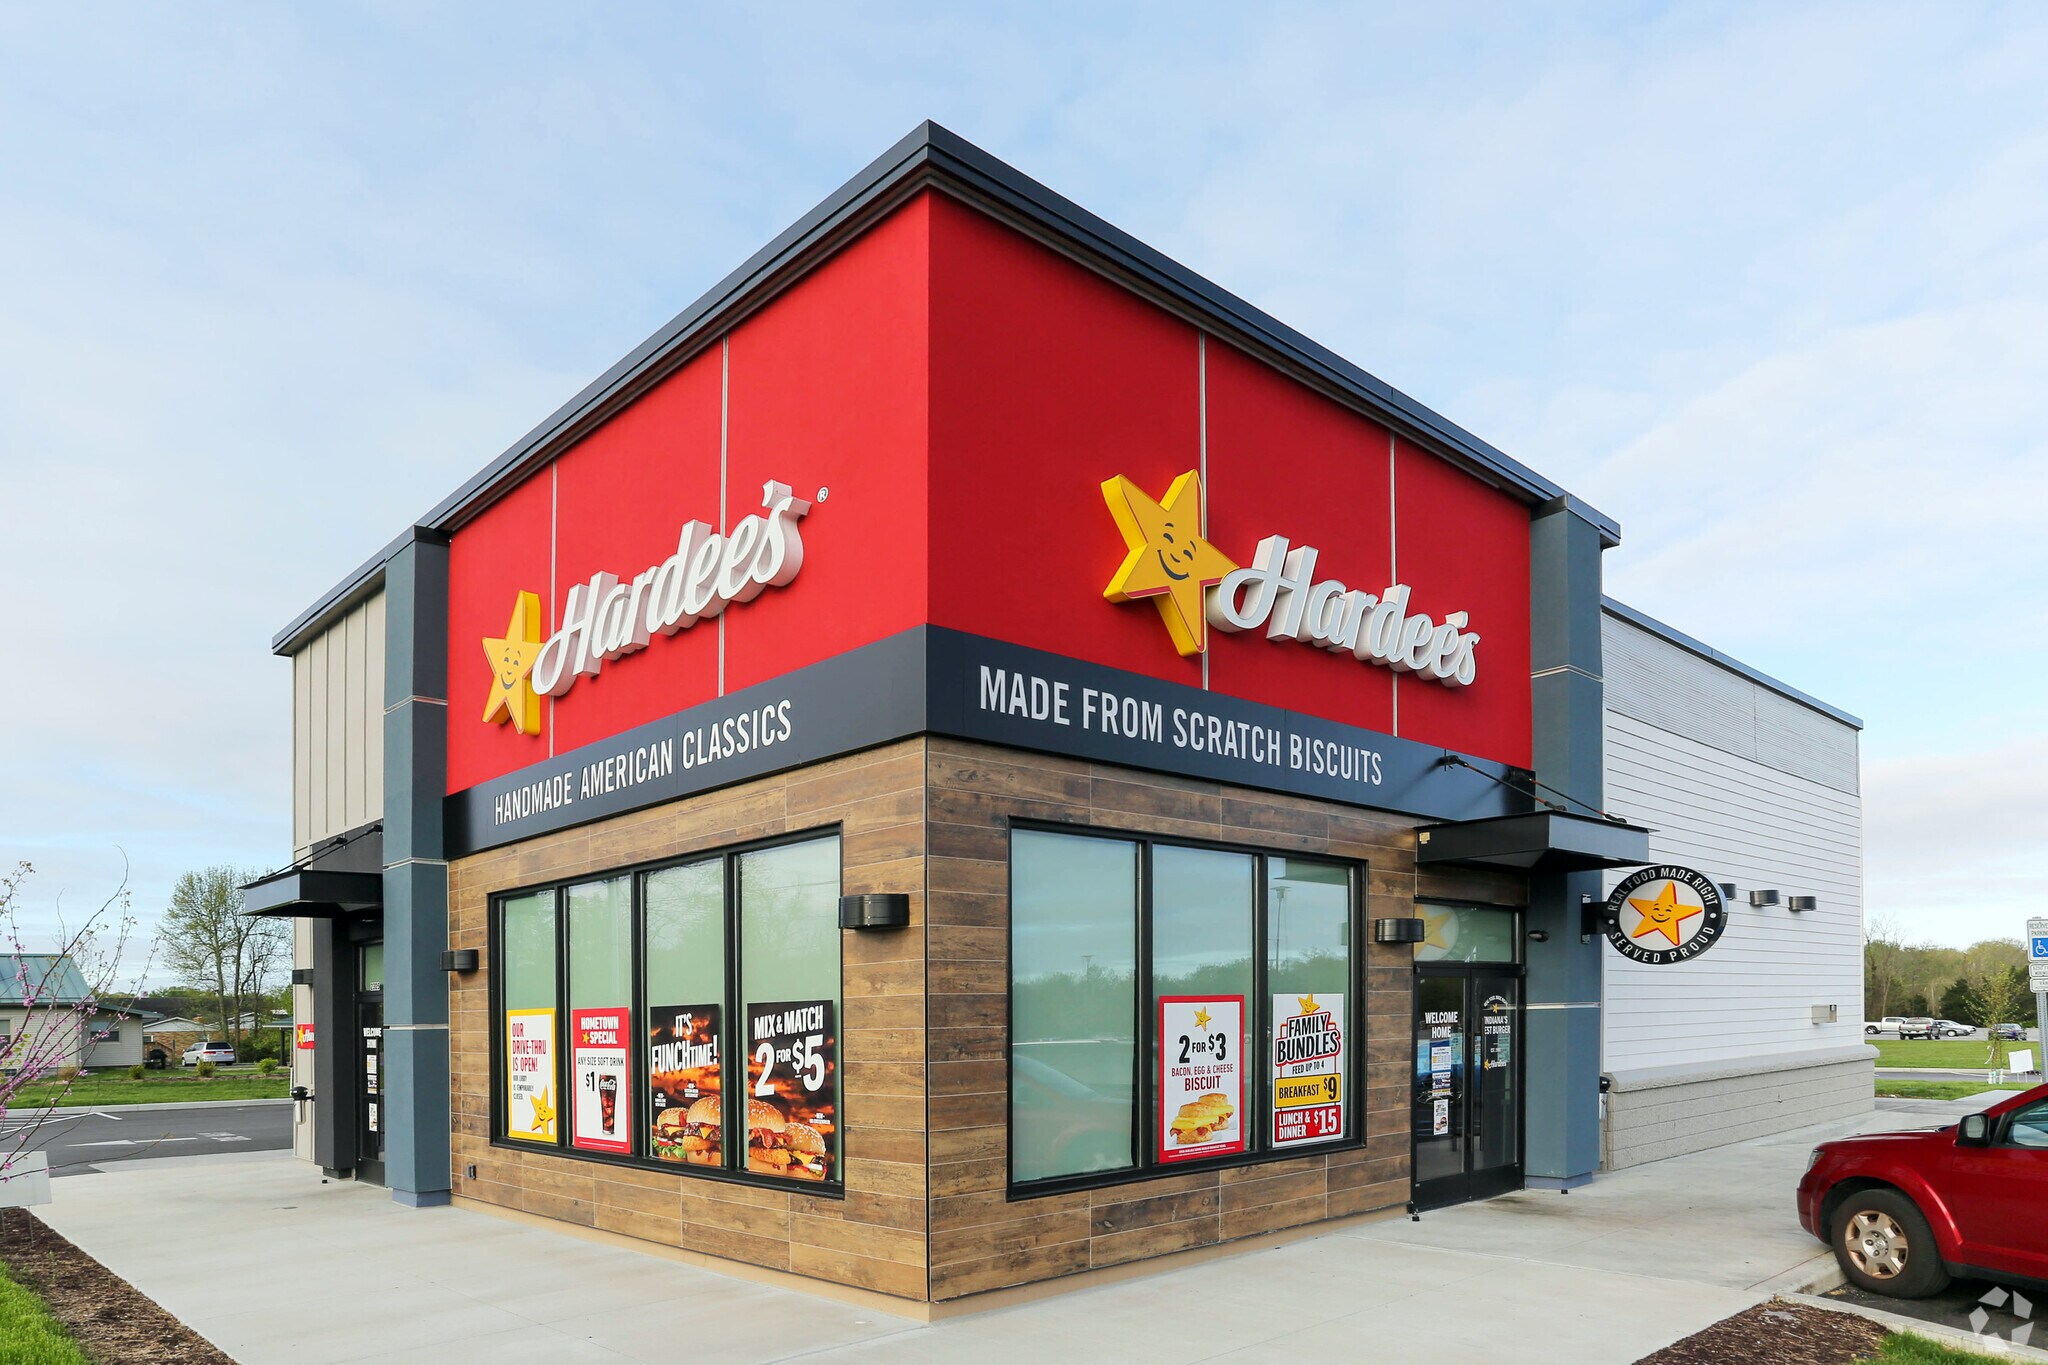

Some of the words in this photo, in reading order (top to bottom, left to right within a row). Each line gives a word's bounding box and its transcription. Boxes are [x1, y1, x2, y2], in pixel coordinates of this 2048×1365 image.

[531, 479, 812, 696] Hardee's
[1205, 534, 1480, 688] Hardee's
[980, 664, 1070, 726] MADE
[1082, 687, 1163, 743] FROM
[1172, 707, 1281, 766] SCRATCH
[1289, 733, 1383, 786] BISCUITS
[494, 771, 573, 826] HANDMADE
[580, 738, 673, 800] AMERICAN
[682, 698, 793, 769] CLASSICS
[1607, 888, 1628, 911] REAL
[1626, 869, 1656, 889] FOOD
[1660, 867, 1693, 882] MADE
[1691, 877, 1719, 905] RIGHT
[1610, 931, 1660, 963] SERVED
[1669, 926, 1715, 961] PROUD
[580, 1016, 619, 1030] HOMETOWN
[675, 1012, 692, 1038] IT'S
[754, 1014, 775, 1040] MIX
[776, 1015, 783, 1033] &
[783, 1005, 824, 1035] MATCH
[1289, 1014, 1328, 1038] FAMILY
[1425, 1011, 1458, 1024] WELCOME
[512, 1023, 524, 1037] OUR
[589, 1031, 618, 1044] SPECIAL
[1431, 1026, 1452, 1038] HOME
[1484, 1026, 1492, 1035] EST
[1493, 1025, 1511, 1035] BURGER
[512, 1040, 547, 1055] DRIVE-THRU
[651, 1034, 718, 1075] FUNCHTIME!
[1178, 1035, 1190, 1064] 2
[1192, 1042, 1206, 1053] FOR
[1208, 1032, 1227, 1061] $3
[1277, 1031, 1338, 1063] BUNDLES
[513, 1057, 518, 1071] IS
[520, 1057, 538, 1072] OPEN!
[577, 1057, 586, 1066] ANY
[587, 1057, 596, 1066] SIZE
[597, 1057, 608, 1066] SOFT
[609, 1057, 625, 1067] DRINK
[755, 1042, 775, 1097] 2
[776, 1049, 791, 1063] FOR
[792, 1034, 825, 1092] $5
[1171, 1067, 1192, 1077] BACON,
[1194, 1066, 1205, 1075] EGG
[1206, 1065, 1211, 1074] &
[1213, 1063, 1234, 1074] CHEESE
[1292, 1064, 1304, 1075] FEED
[1305, 1063, 1312, 1072] UP
[1313, 1061, 1320, 1070] TO
[1321, 1060, 1325, 1069] 4
[585, 1071, 595, 1092] $1
[1184, 1075, 1221, 1092] BISCUIT
[1279, 1083, 1320, 1099] BREAKFAST
[1323, 1076, 1337, 1100] $9
[1279, 1111, 1303, 1126] LUNCH
[1305, 1111, 1310, 1123] &
[1313, 1108, 1337, 1134] $15
[1279, 1124, 1306, 1140] DINNER
